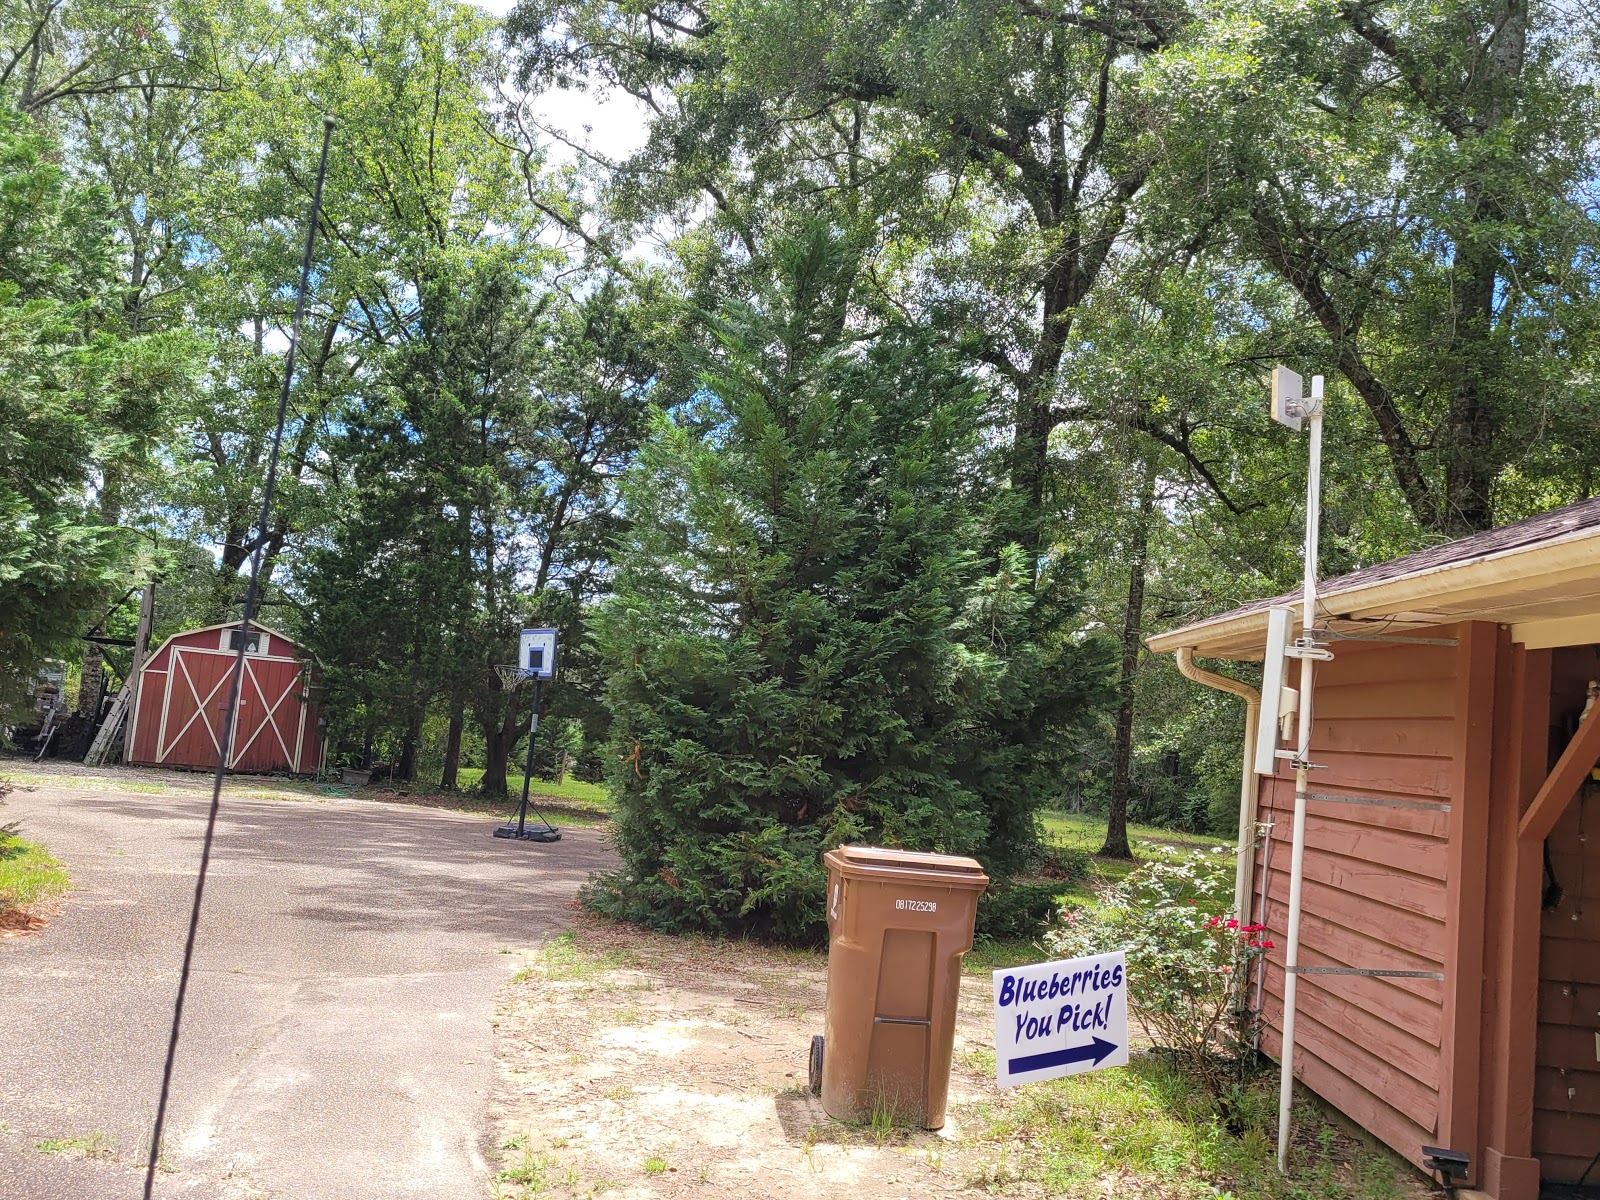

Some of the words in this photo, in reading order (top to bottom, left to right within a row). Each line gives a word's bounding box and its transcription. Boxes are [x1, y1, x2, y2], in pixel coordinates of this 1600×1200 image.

[895, 899, 937, 912] 0817225298
[998, 963, 1123, 1007] Blueberries
[1015, 1010, 1053, 1045] You
[1056, 993, 1114, 1034] Pick!
